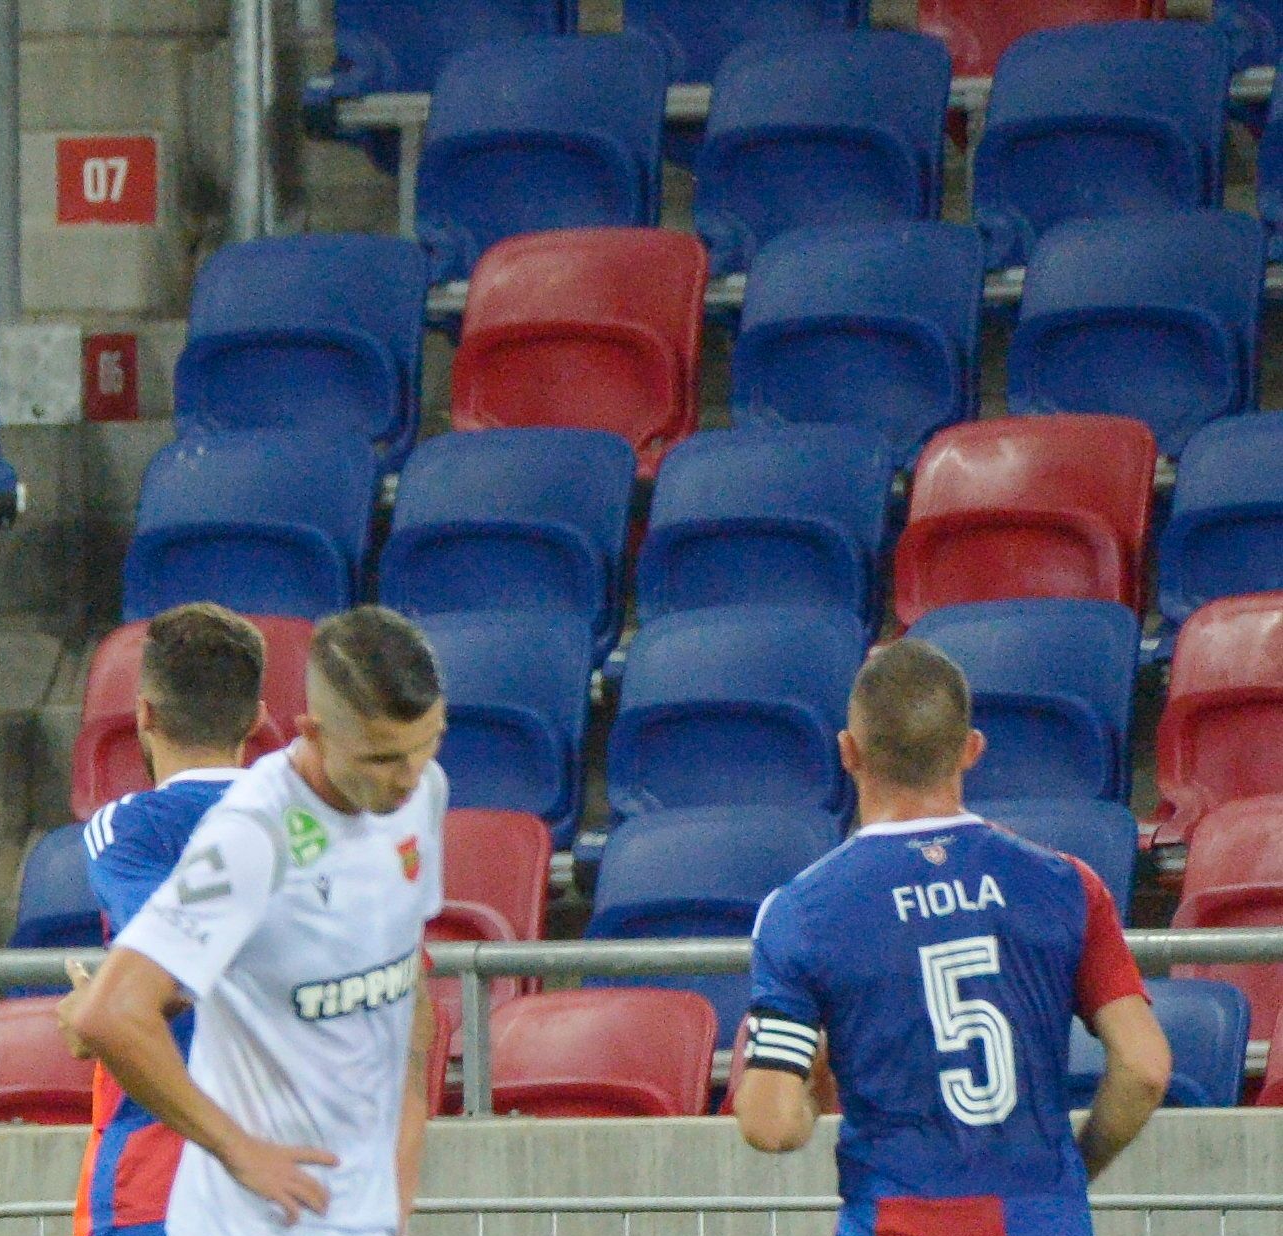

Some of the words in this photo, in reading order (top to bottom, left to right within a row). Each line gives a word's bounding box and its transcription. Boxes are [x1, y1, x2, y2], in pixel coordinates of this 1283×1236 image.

[83, 157, 128, 202] 07
[892, 874, 1006, 923] FIOLA
[919, 934, 1018, 1126] 5
